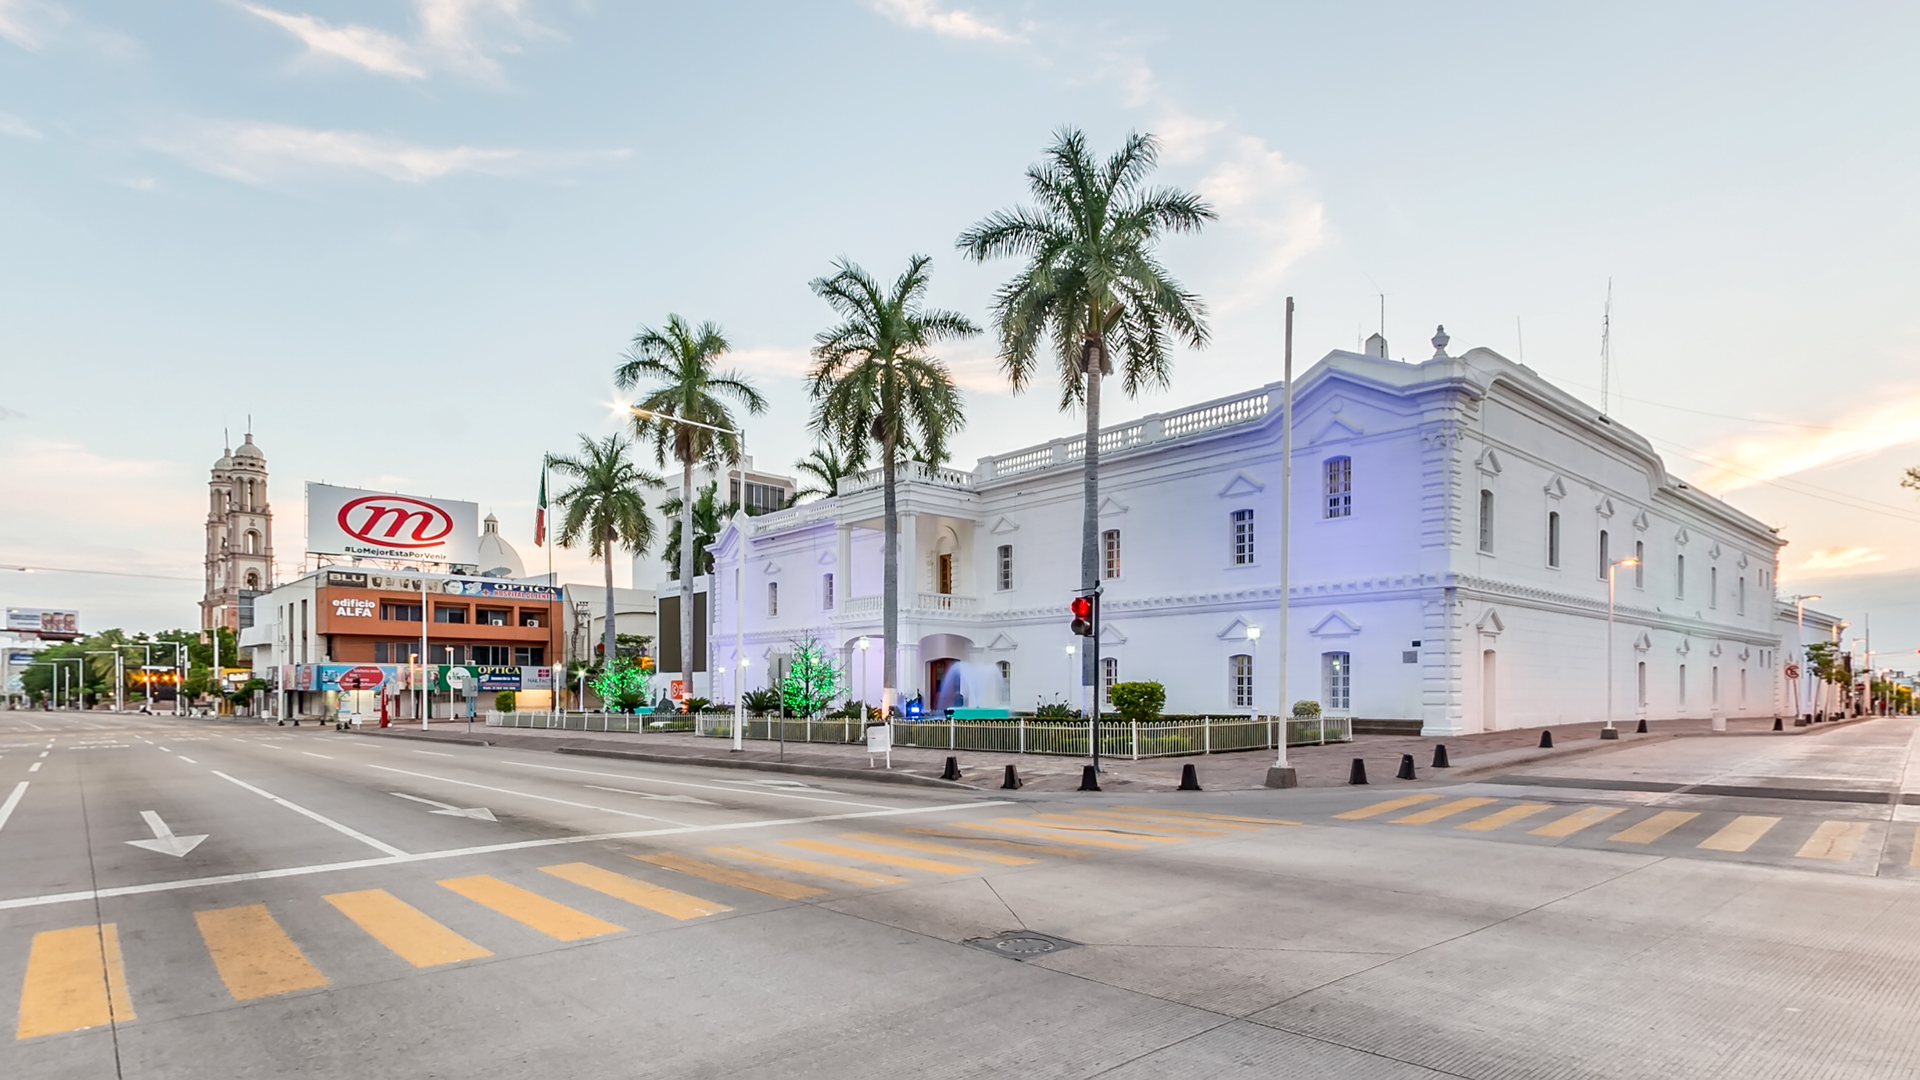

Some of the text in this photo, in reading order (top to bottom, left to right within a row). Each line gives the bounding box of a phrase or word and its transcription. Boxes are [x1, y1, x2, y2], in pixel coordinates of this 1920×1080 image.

[345, 546, 447, 560] #LoMejorEstaPorVenir
[329, 573, 366, 582] BLU
[493, 590, 525, 598] HOSPITAL
[332, 599, 376, 608] edificio
[336, 608, 373, 617] ALFA
[478, 666, 520, 674] OPTICA
